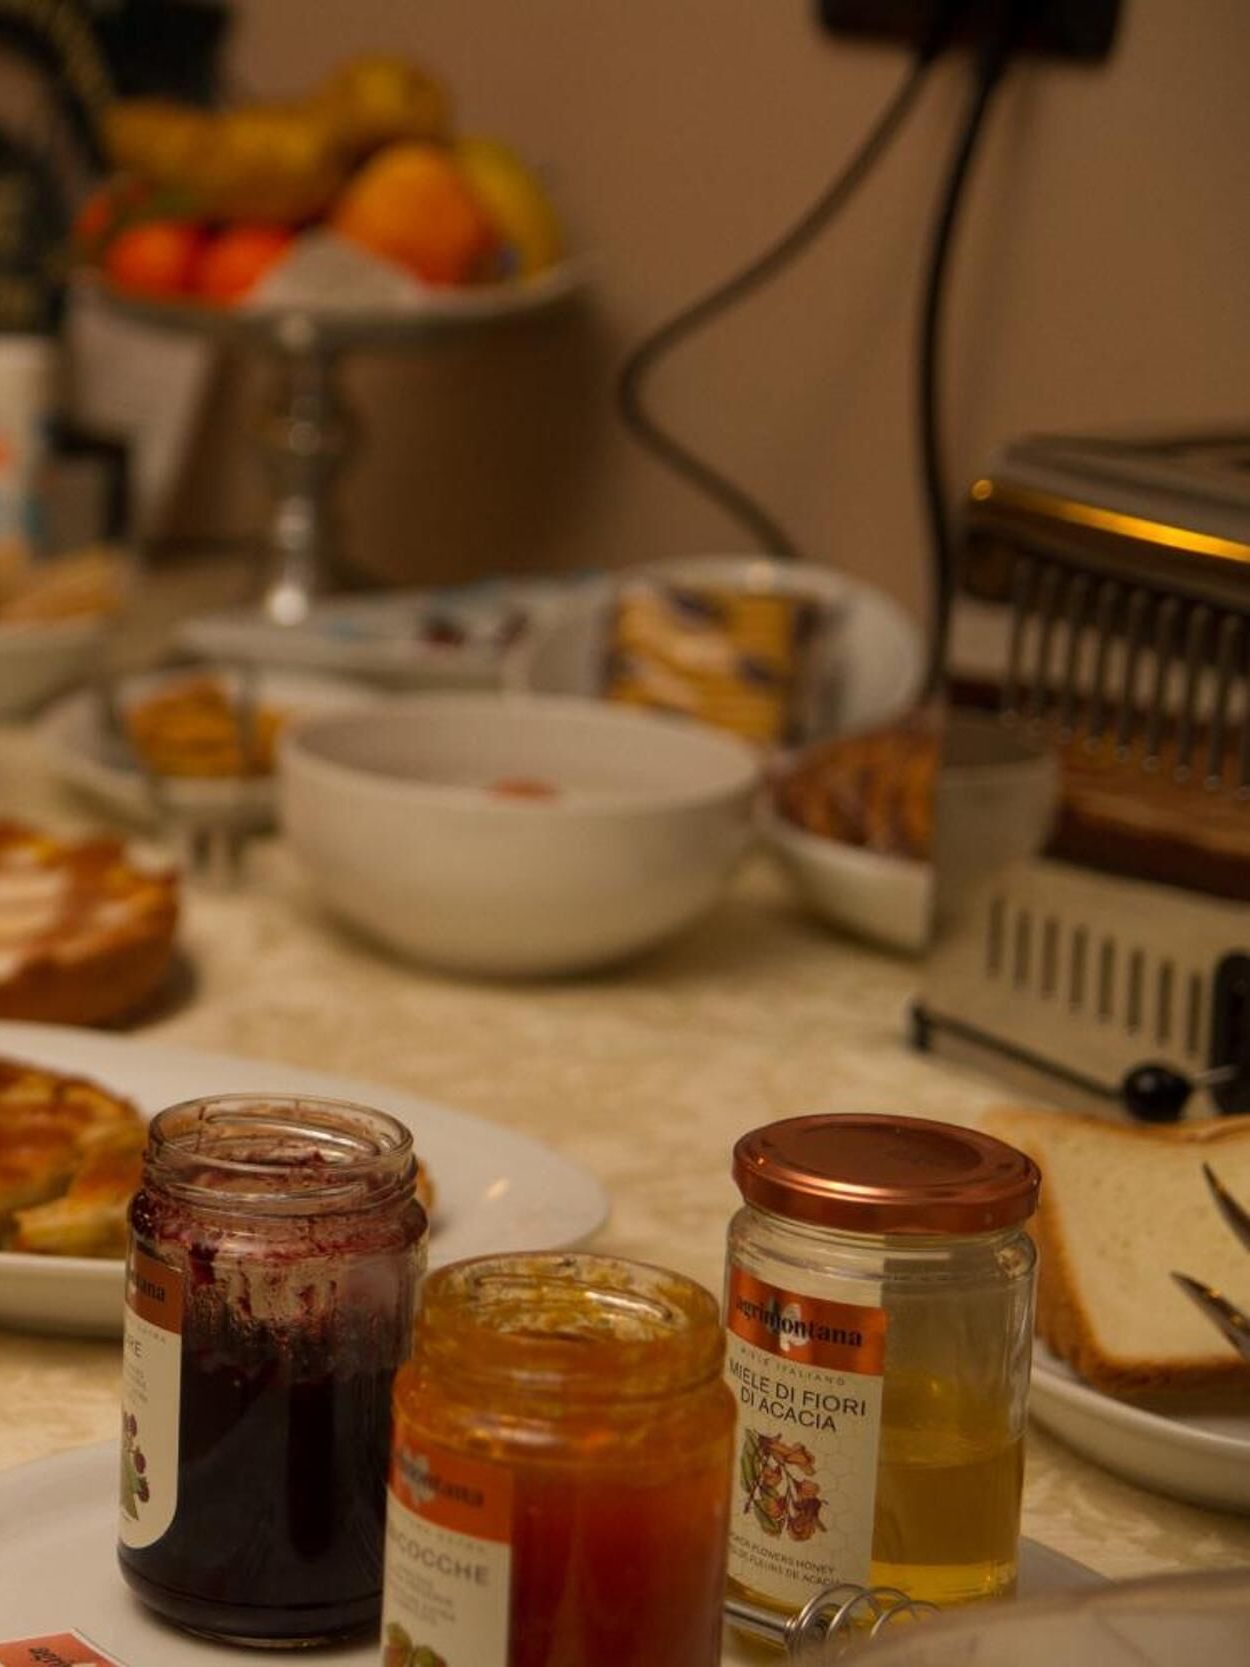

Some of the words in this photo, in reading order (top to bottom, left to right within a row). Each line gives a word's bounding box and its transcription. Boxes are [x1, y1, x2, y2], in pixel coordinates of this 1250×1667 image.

[730, 1357, 770, 1394] MIELE
[775, 1383, 795, 1404] DI
[803, 1390, 866, 1417] FIORI
[741, 1386, 755, 1408] DI
[758, 1397, 837, 1433] ACACIA
[796, 1559, 835, 1576] HONEY
